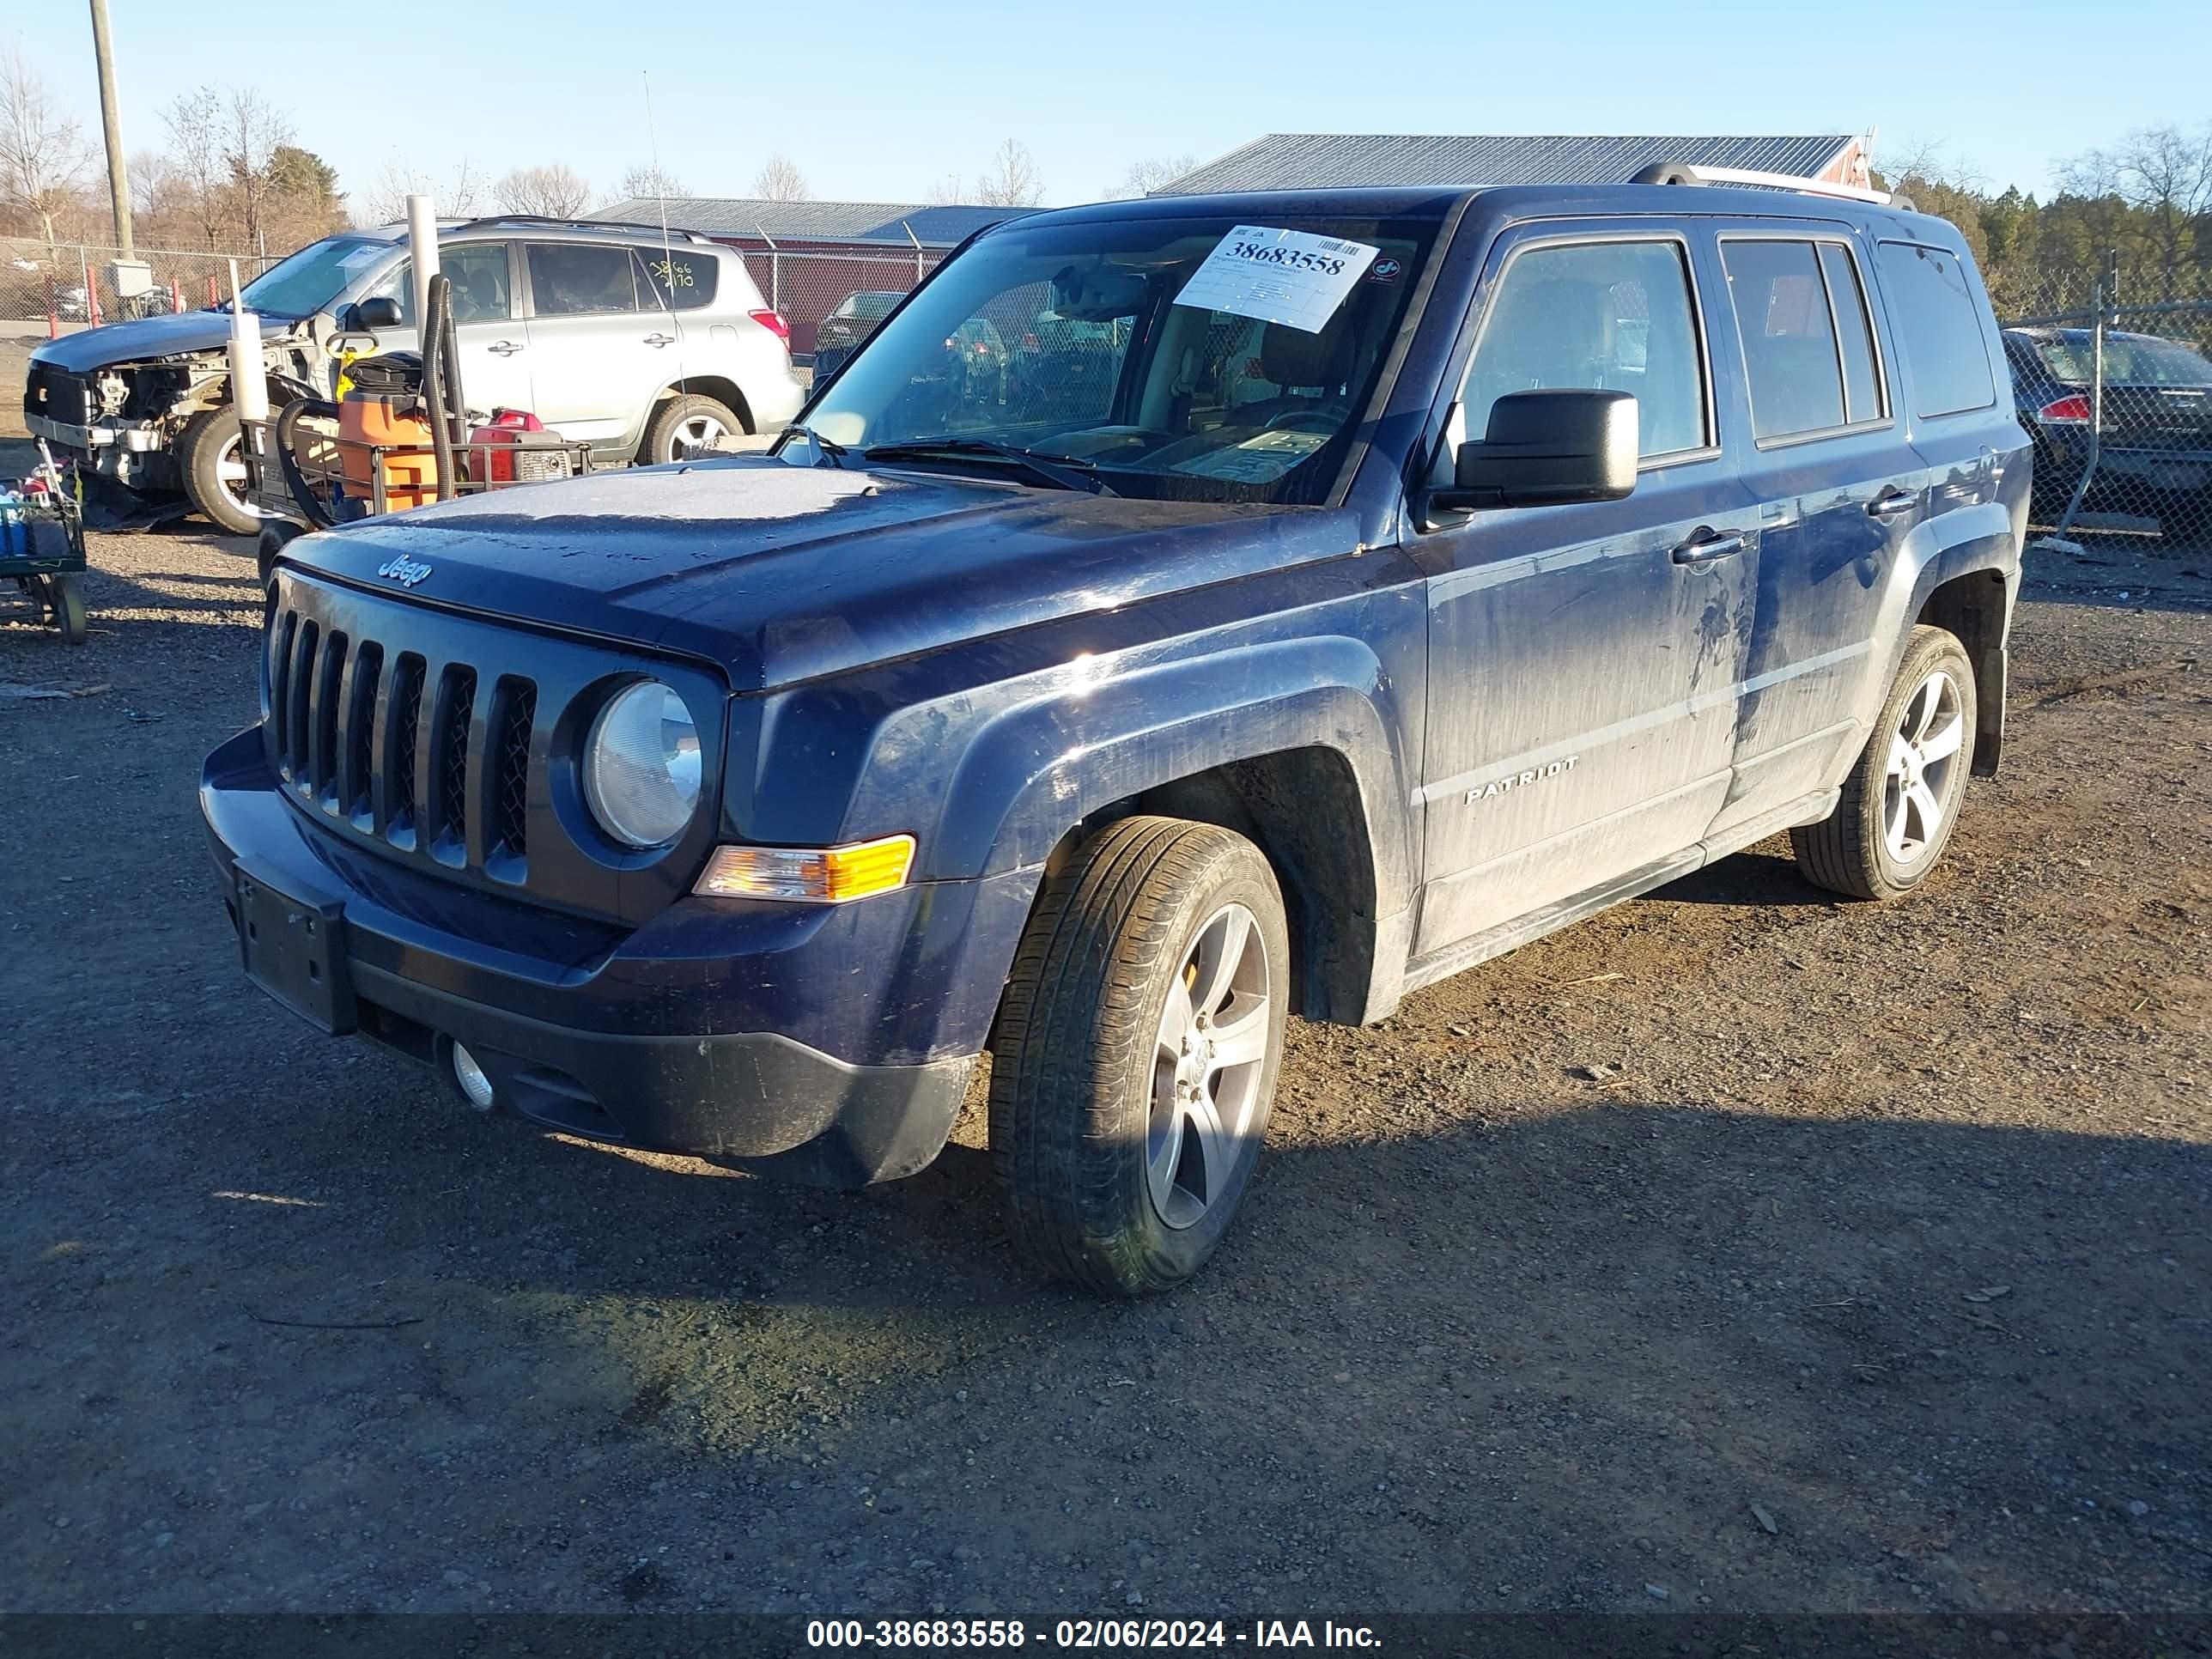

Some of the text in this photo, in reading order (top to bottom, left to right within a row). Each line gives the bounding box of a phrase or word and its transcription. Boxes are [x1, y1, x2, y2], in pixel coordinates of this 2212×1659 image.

[649, 260, 692, 276] 3866
[1225, 241, 1346, 276] 38683558
[378, 554, 433, 588] Jeep
[1463, 756, 1580, 806] PATRIOT
